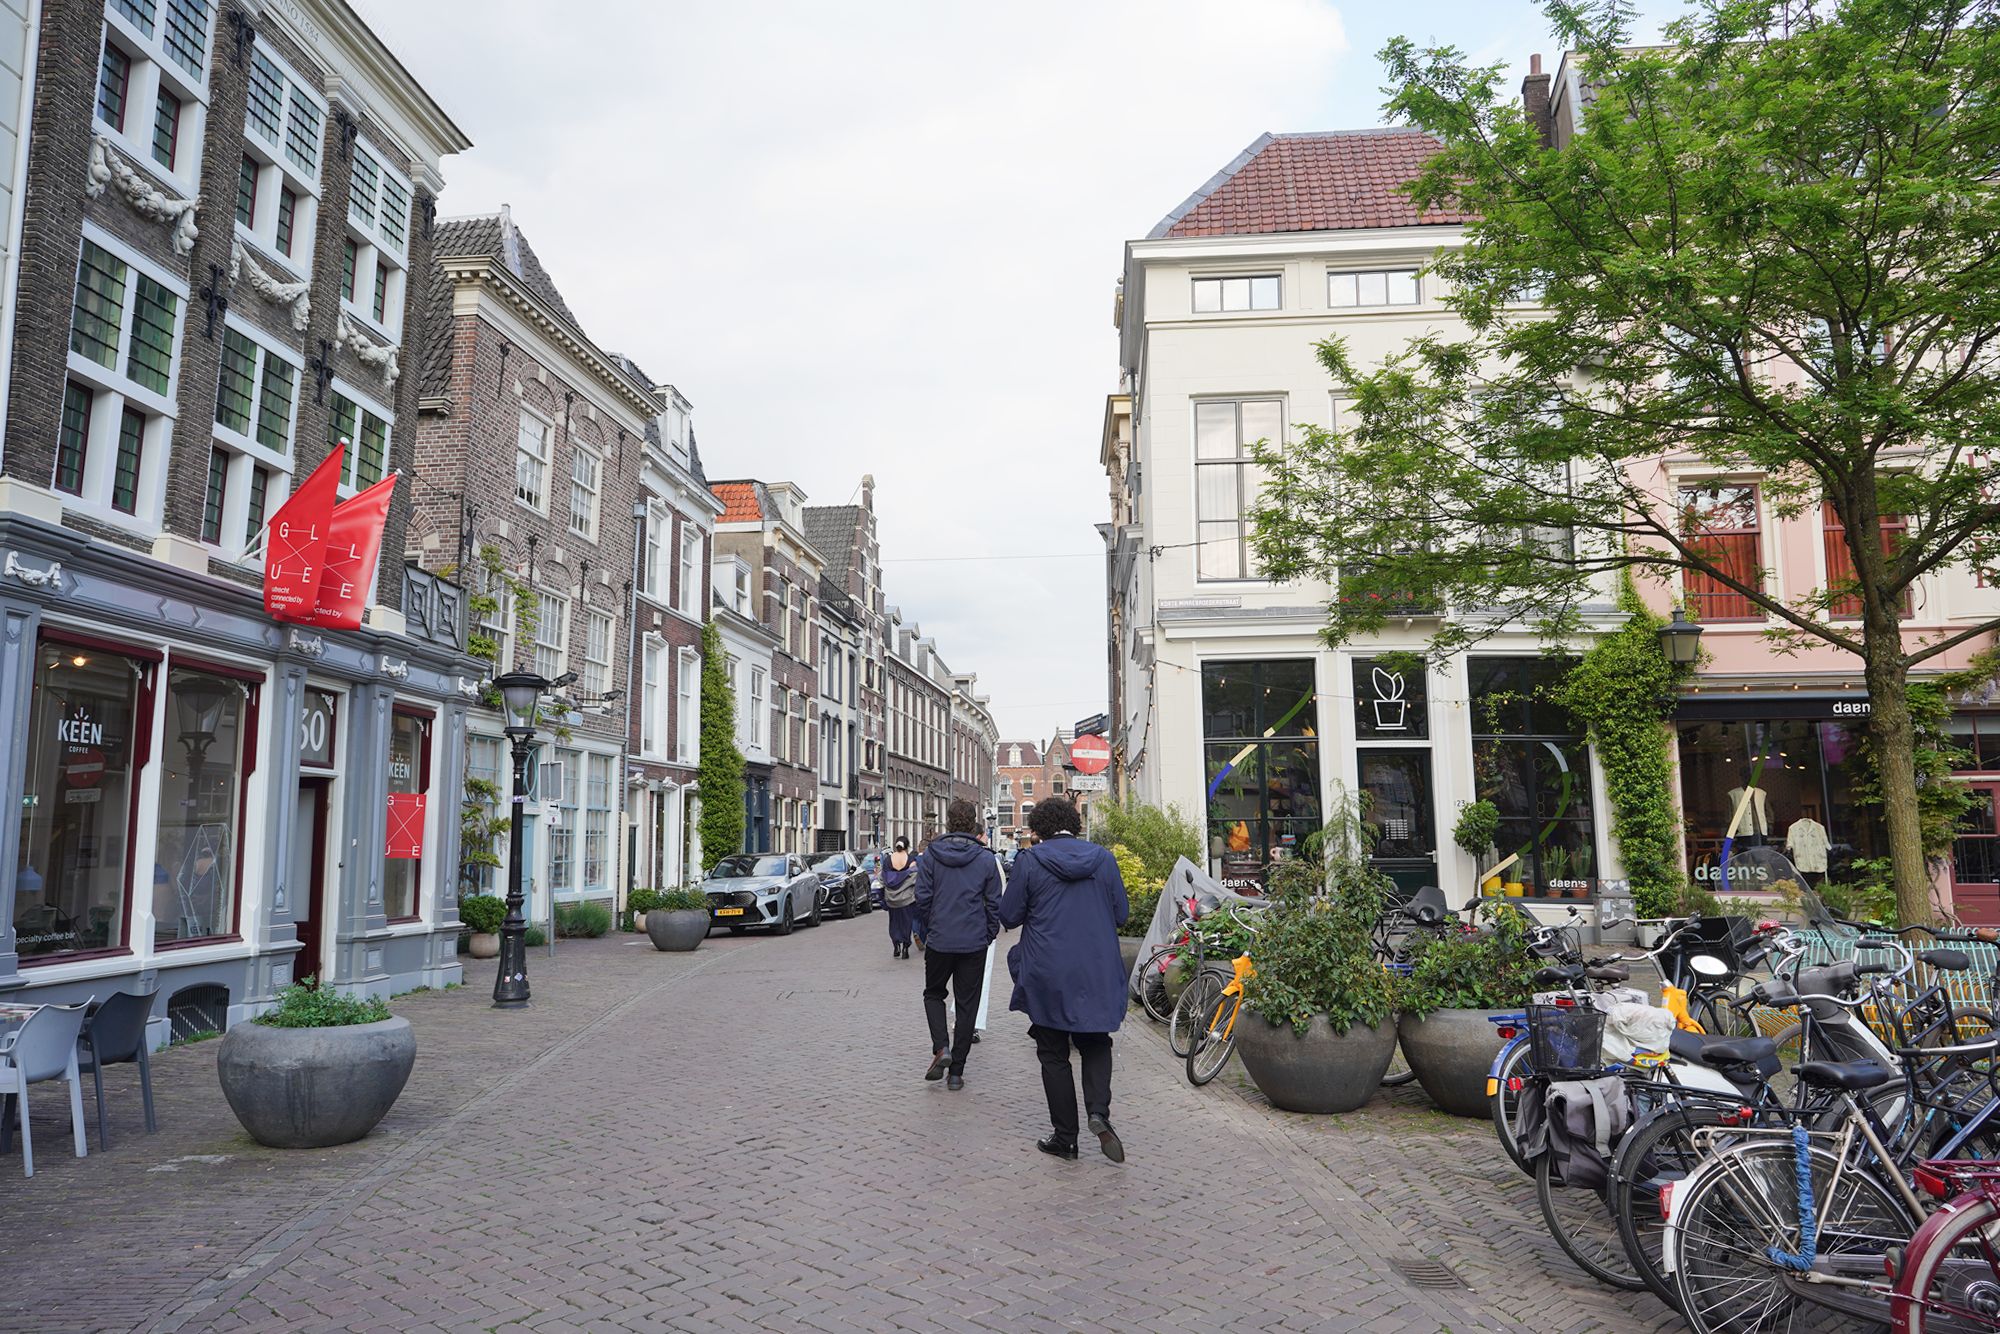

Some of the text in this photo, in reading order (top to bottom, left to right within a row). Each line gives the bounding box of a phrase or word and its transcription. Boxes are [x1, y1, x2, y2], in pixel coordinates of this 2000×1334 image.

[279, 522, 318, 540] G L
[349, 543, 361, 559] L
[270, 563, 312, 583] U E
[340, 583, 354, 599] E
[1832, 701, 1871, 714] daen
[57, 719, 102, 745] KEEN
[68, 746, 89, 754] COFFEE
[388, 762, 410, 779] KEEN
[415, 797, 424, 807] L
[411, 845, 421, 857] E
[1549, 878, 1588, 888] daen's
[16, 930, 76, 944] pecialty coffee bar
